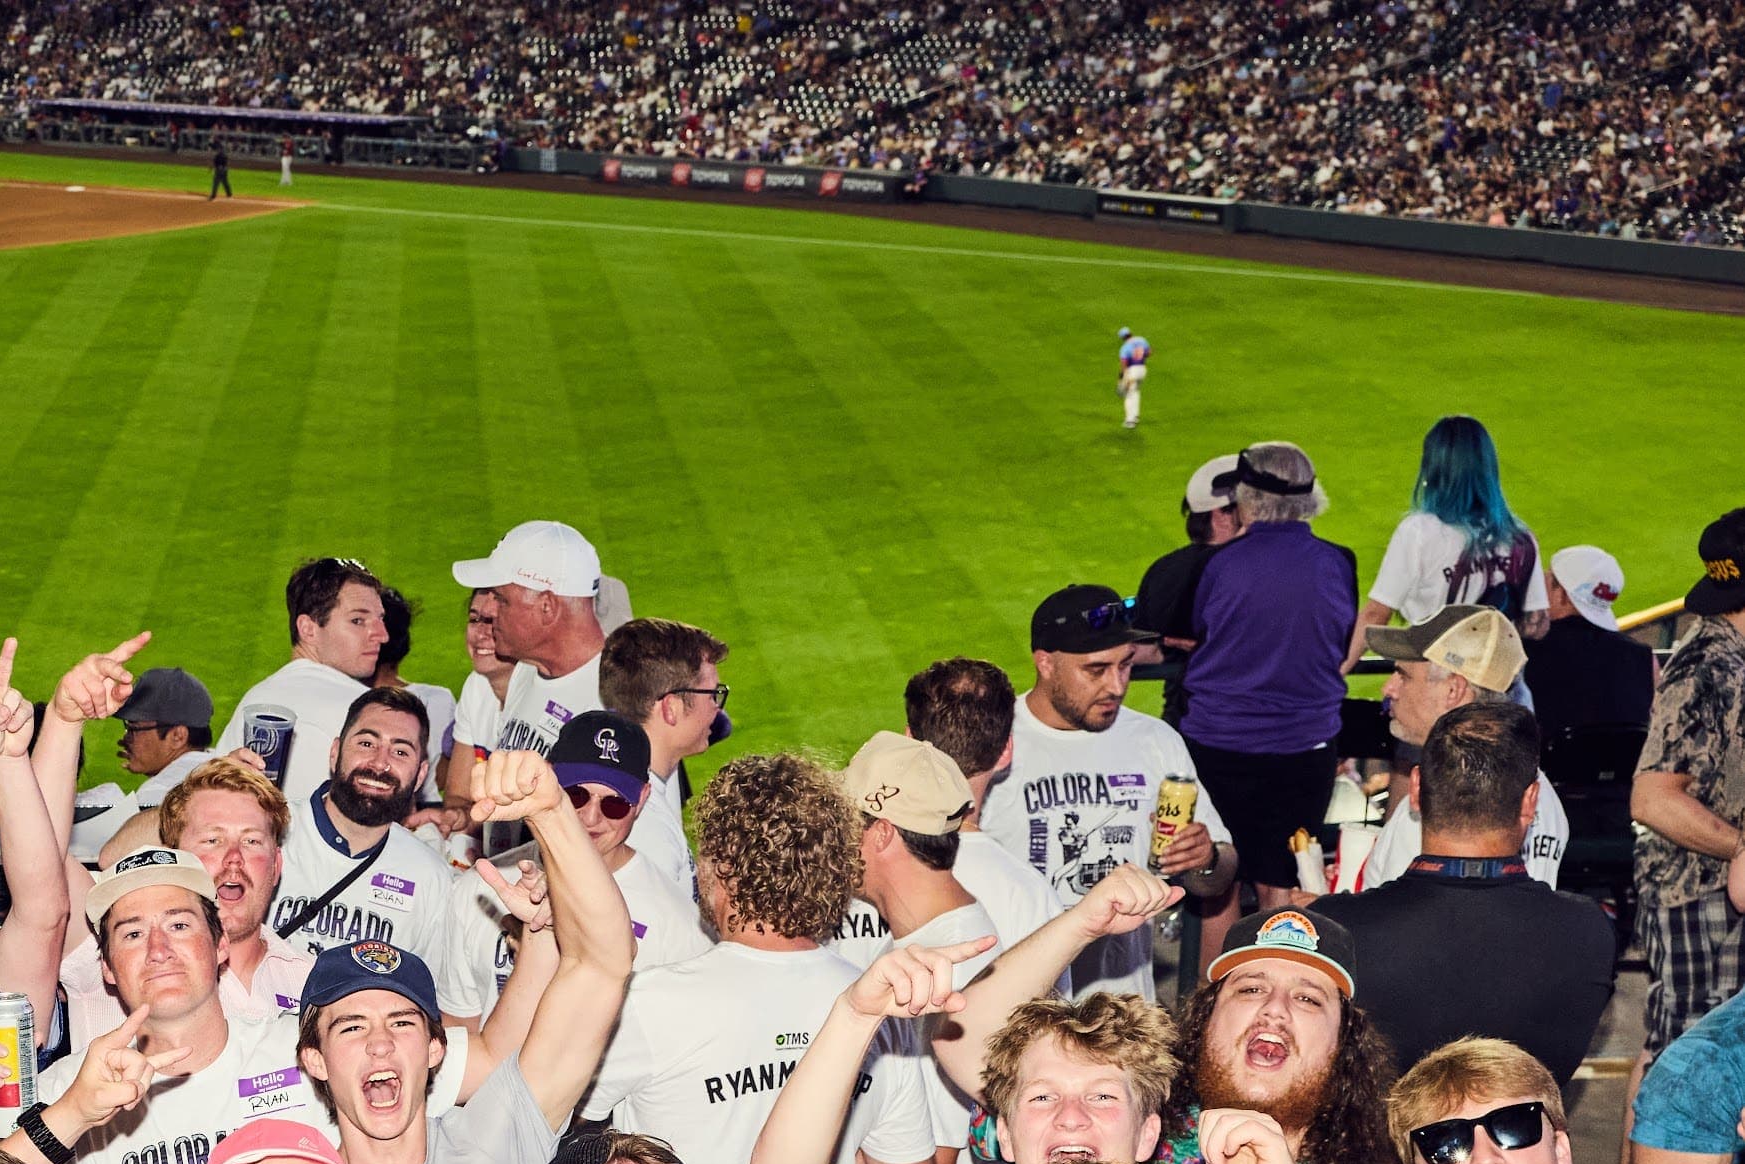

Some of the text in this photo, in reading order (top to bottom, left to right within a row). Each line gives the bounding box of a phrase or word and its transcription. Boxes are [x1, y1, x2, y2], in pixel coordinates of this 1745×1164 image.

[621, 164, 657, 178] TOYOTA
[691, 169, 730, 183] TOYOTA
[765, 173, 805, 187] TOYOTA
[842, 178, 885, 192] TOYOTA
[382, 875, 404, 889] Hello
[372, 888, 404, 905] RYAN
[785, 1032, 809, 1045] TMS
[252, 1072, 285, 1089] Hello
[248, 1092, 289, 1112] RYAN
